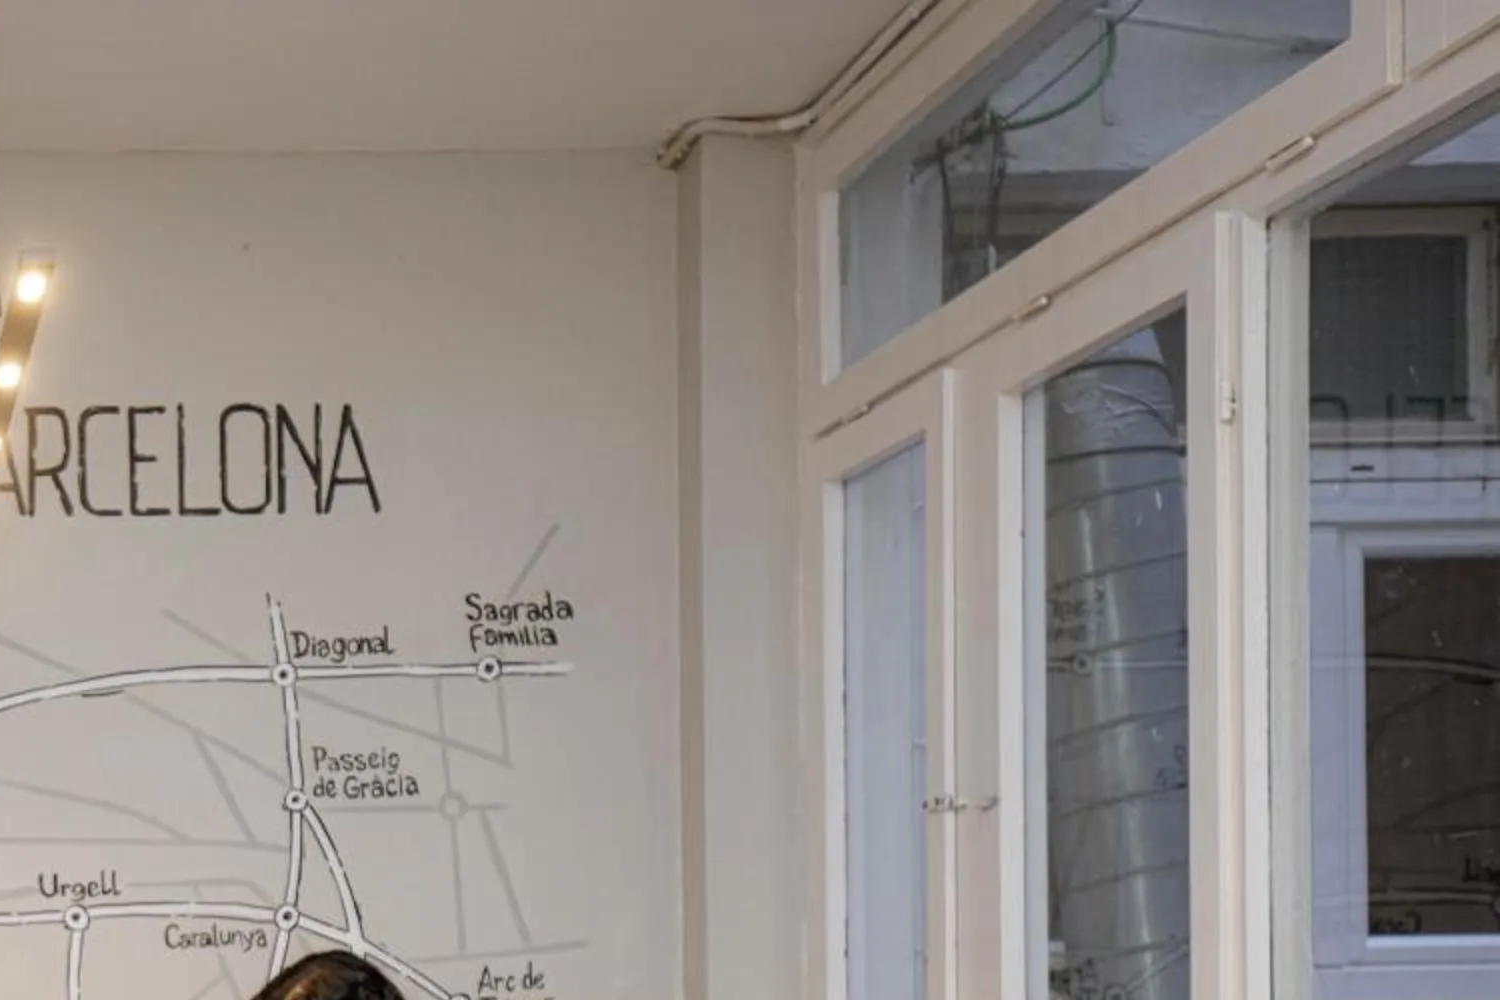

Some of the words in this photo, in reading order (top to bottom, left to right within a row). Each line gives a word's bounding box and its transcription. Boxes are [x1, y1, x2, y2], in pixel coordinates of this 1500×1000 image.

[464, 590, 575, 626] Sagrada
[290, 626, 395, 663] Diagonal
[312, 745, 400, 775] Passeig
[313, 774, 337, 798] de
[38, 869, 122, 902] Urgell
[477, 963, 516, 994] Arc
[522, 960, 546, 991] de
